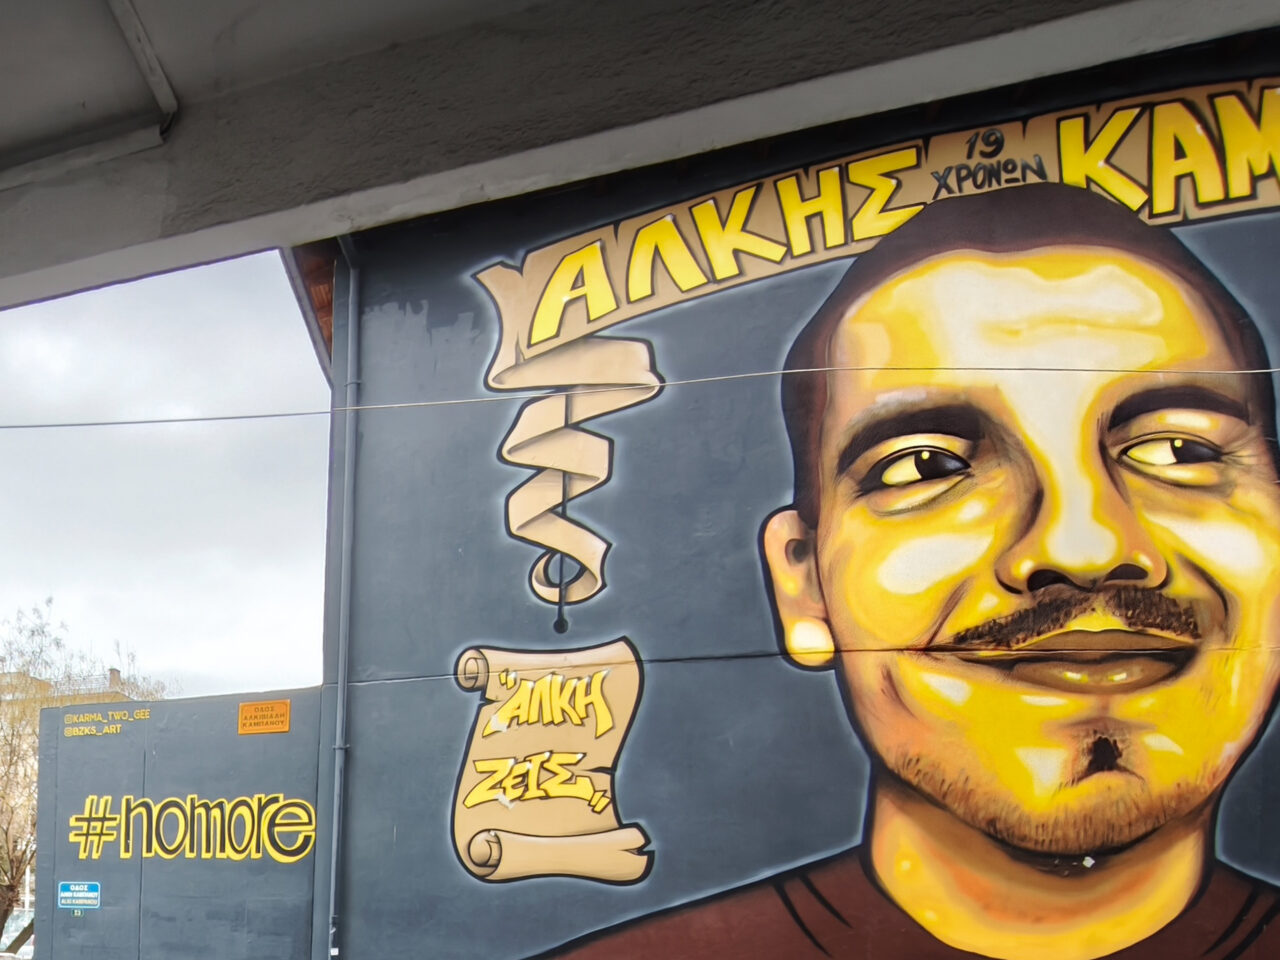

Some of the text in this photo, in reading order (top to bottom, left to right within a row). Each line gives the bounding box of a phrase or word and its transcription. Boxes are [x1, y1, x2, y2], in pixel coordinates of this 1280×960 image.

[965, 128, 1005, 160] 19
[930, 154, 1048, 200] ΧΡΟΝΩΝ
[529, 147, 924, 347] ΑΛΚΗΣ
[69, 793, 316, 863] #nomore
